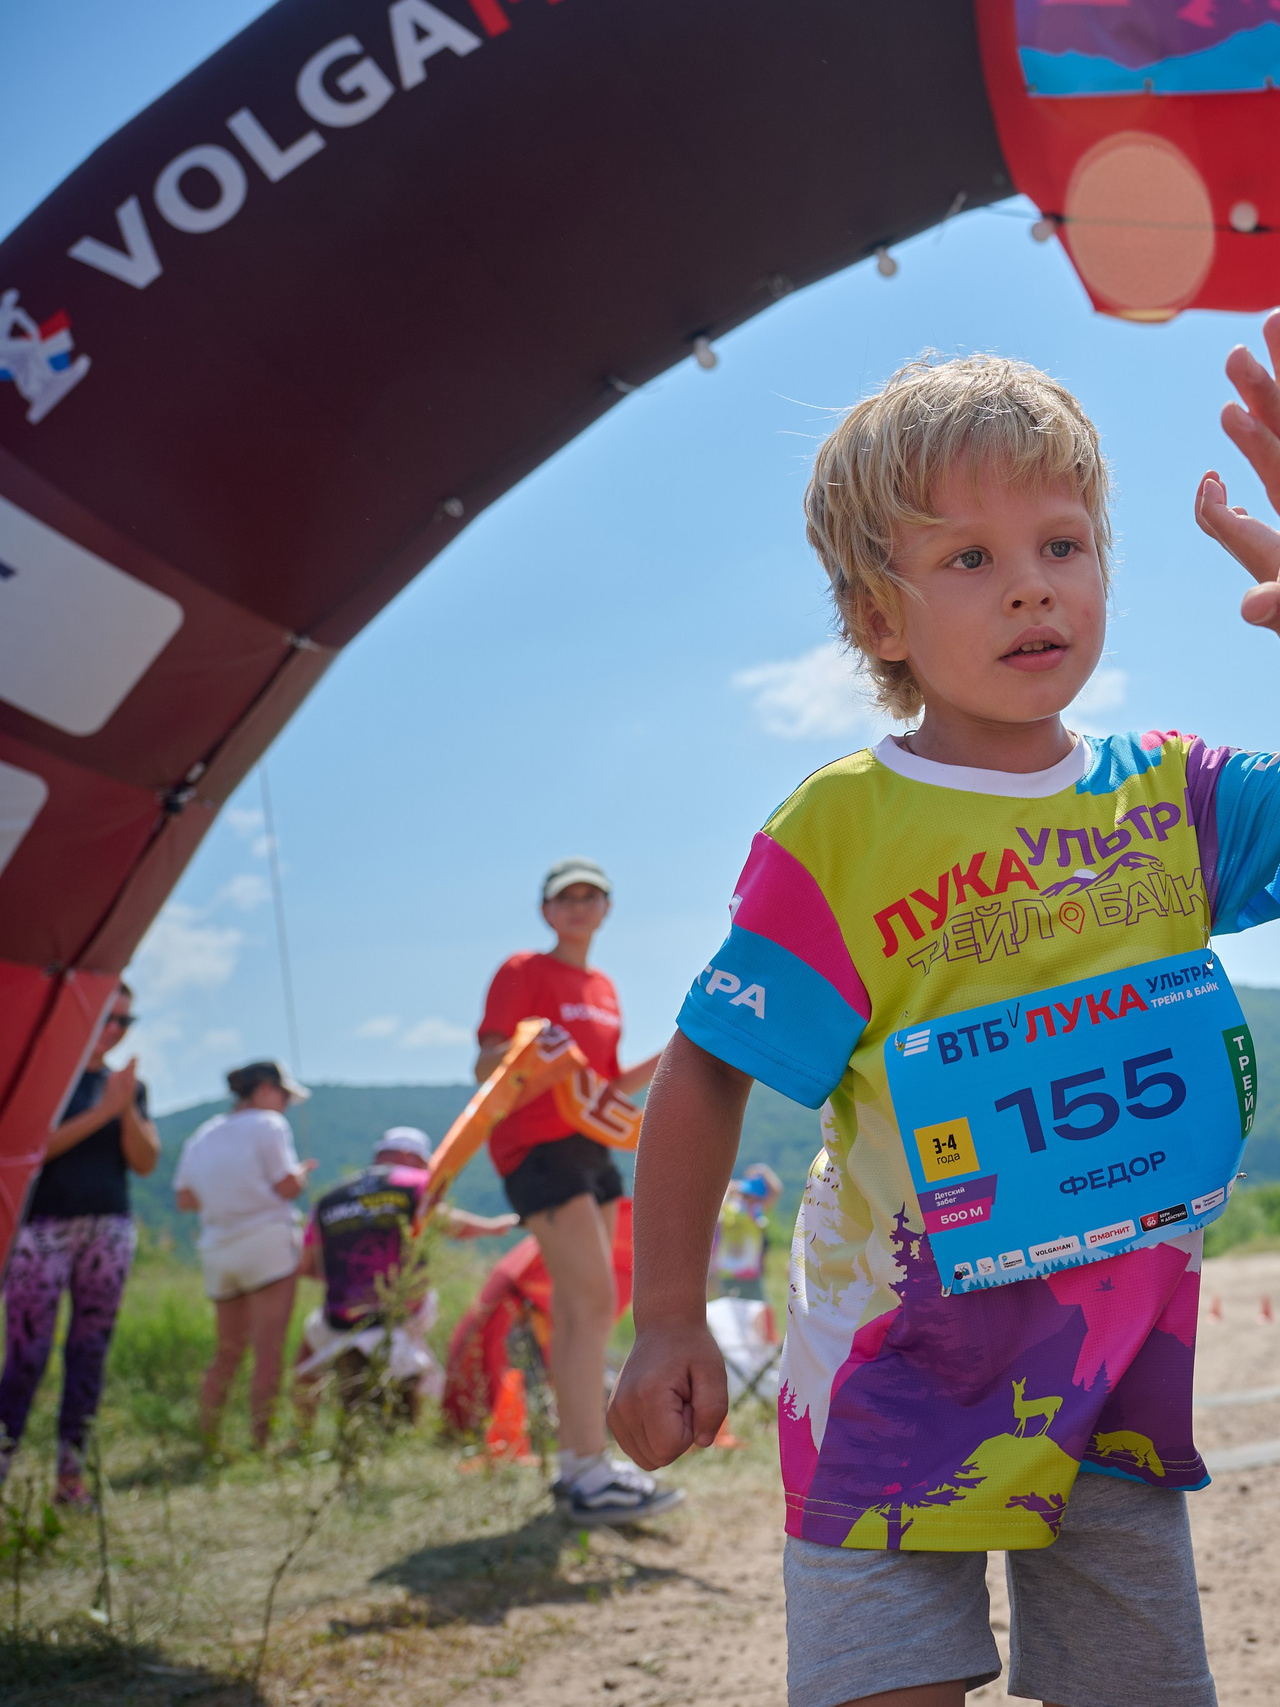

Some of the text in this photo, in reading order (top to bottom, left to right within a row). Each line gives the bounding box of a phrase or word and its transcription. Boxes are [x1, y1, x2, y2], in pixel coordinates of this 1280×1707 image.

[68, 0, 512, 290] VOLGA
[873, 848, 1039, 958] ЛУКА
[907, 860, 1204, 977] ТЕЙЛ БАЙК
[697, 964, 766, 1020] РА
[936, 963, 1214, 1065] ВТБ ЛУКА УЛЬТРА
[1150, 982, 1219, 1008] ТРЕЙЛ & БАЙК
[994, 1047, 1187, 1154] 155
[1232, 1035, 1253, 1131] ТРЕЙЛ
[932, 1134, 957, 1154] 3-4
[936, 1152, 961, 1165] года
[934, 1186, 965, 1201] Детский
[1059, 1151, 1166, 1195] ФЕДОР
[936, 1197, 957, 1207] забег
[940, 1210, 968, 1225] 500
